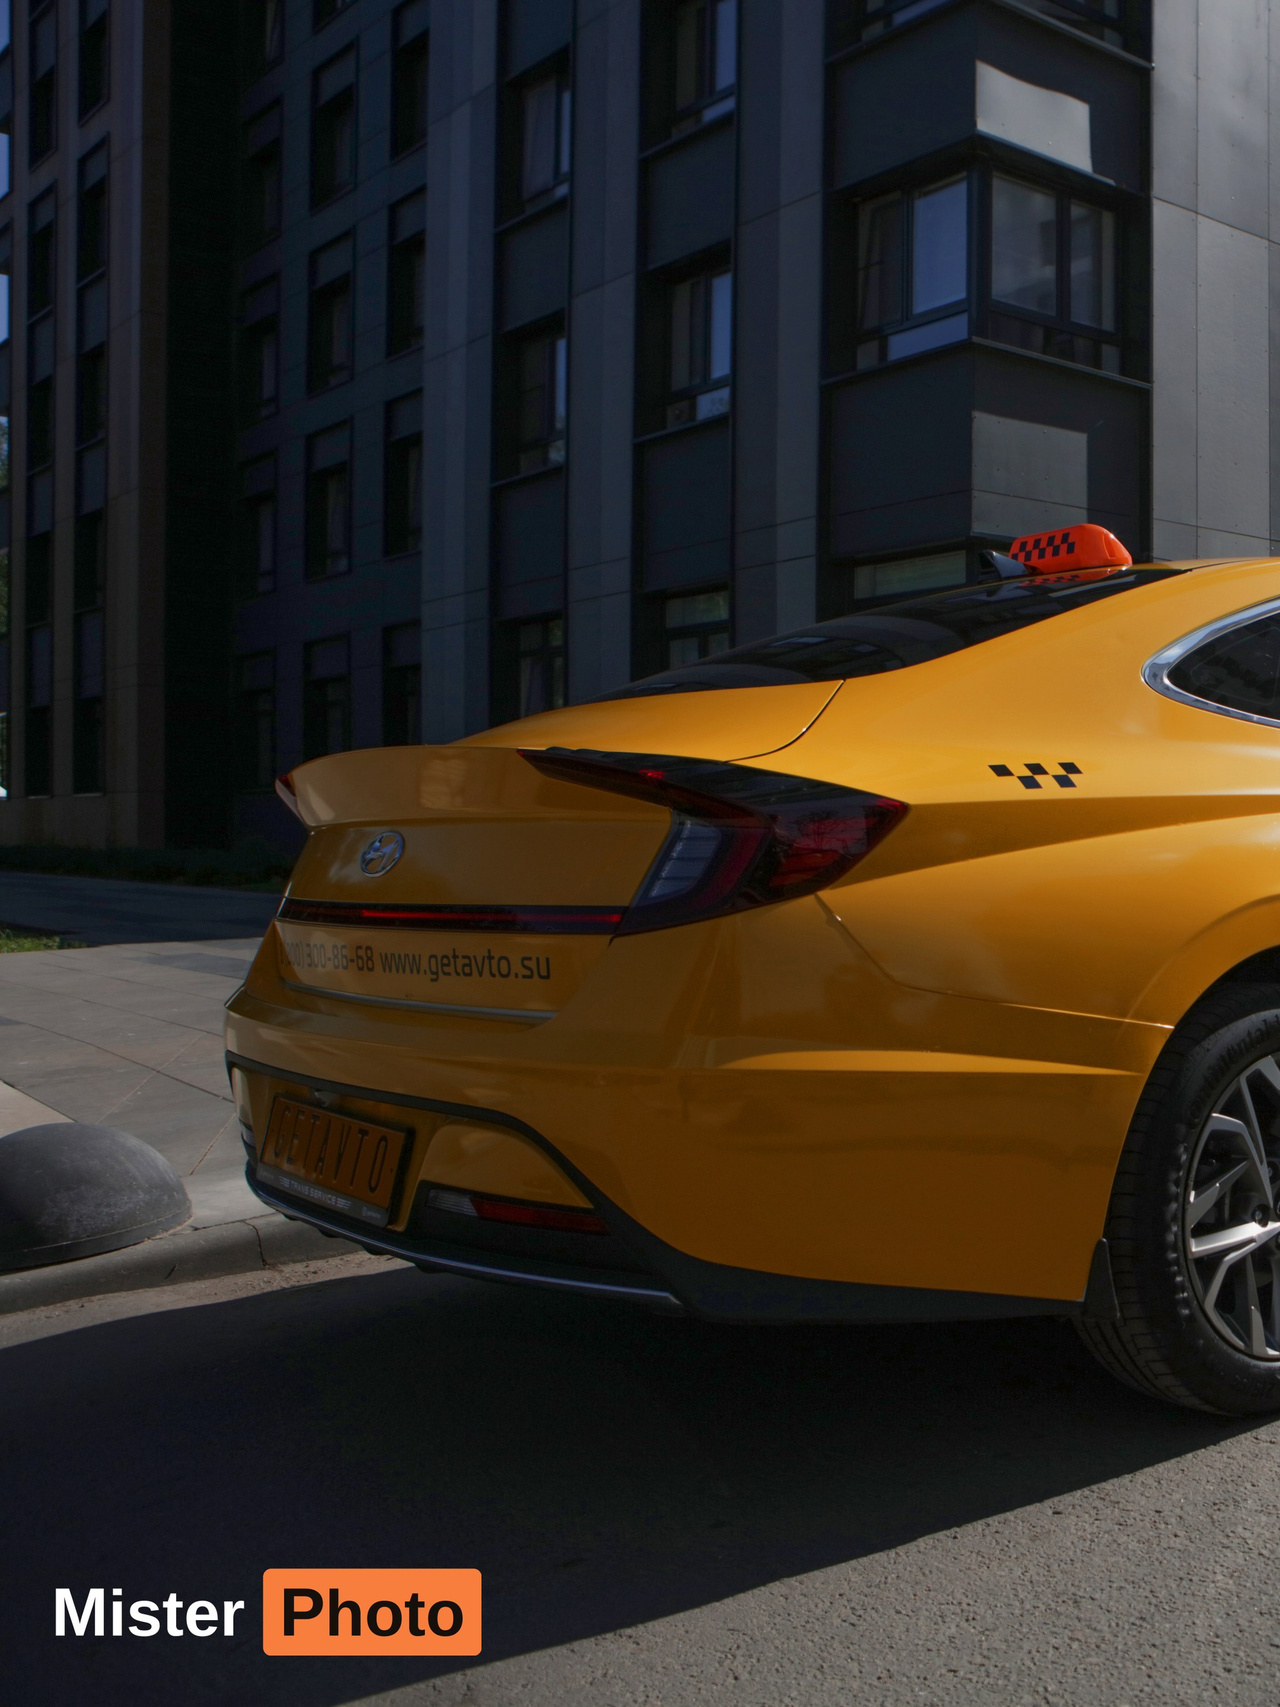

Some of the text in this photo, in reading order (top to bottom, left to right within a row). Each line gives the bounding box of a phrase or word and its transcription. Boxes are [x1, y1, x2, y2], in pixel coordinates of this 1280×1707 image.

[379, 949, 551, 982] www.getavto.su
[273, 1105, 388, 1194] GETAVTO
[289, 1180, 309, 1196] TRANS
